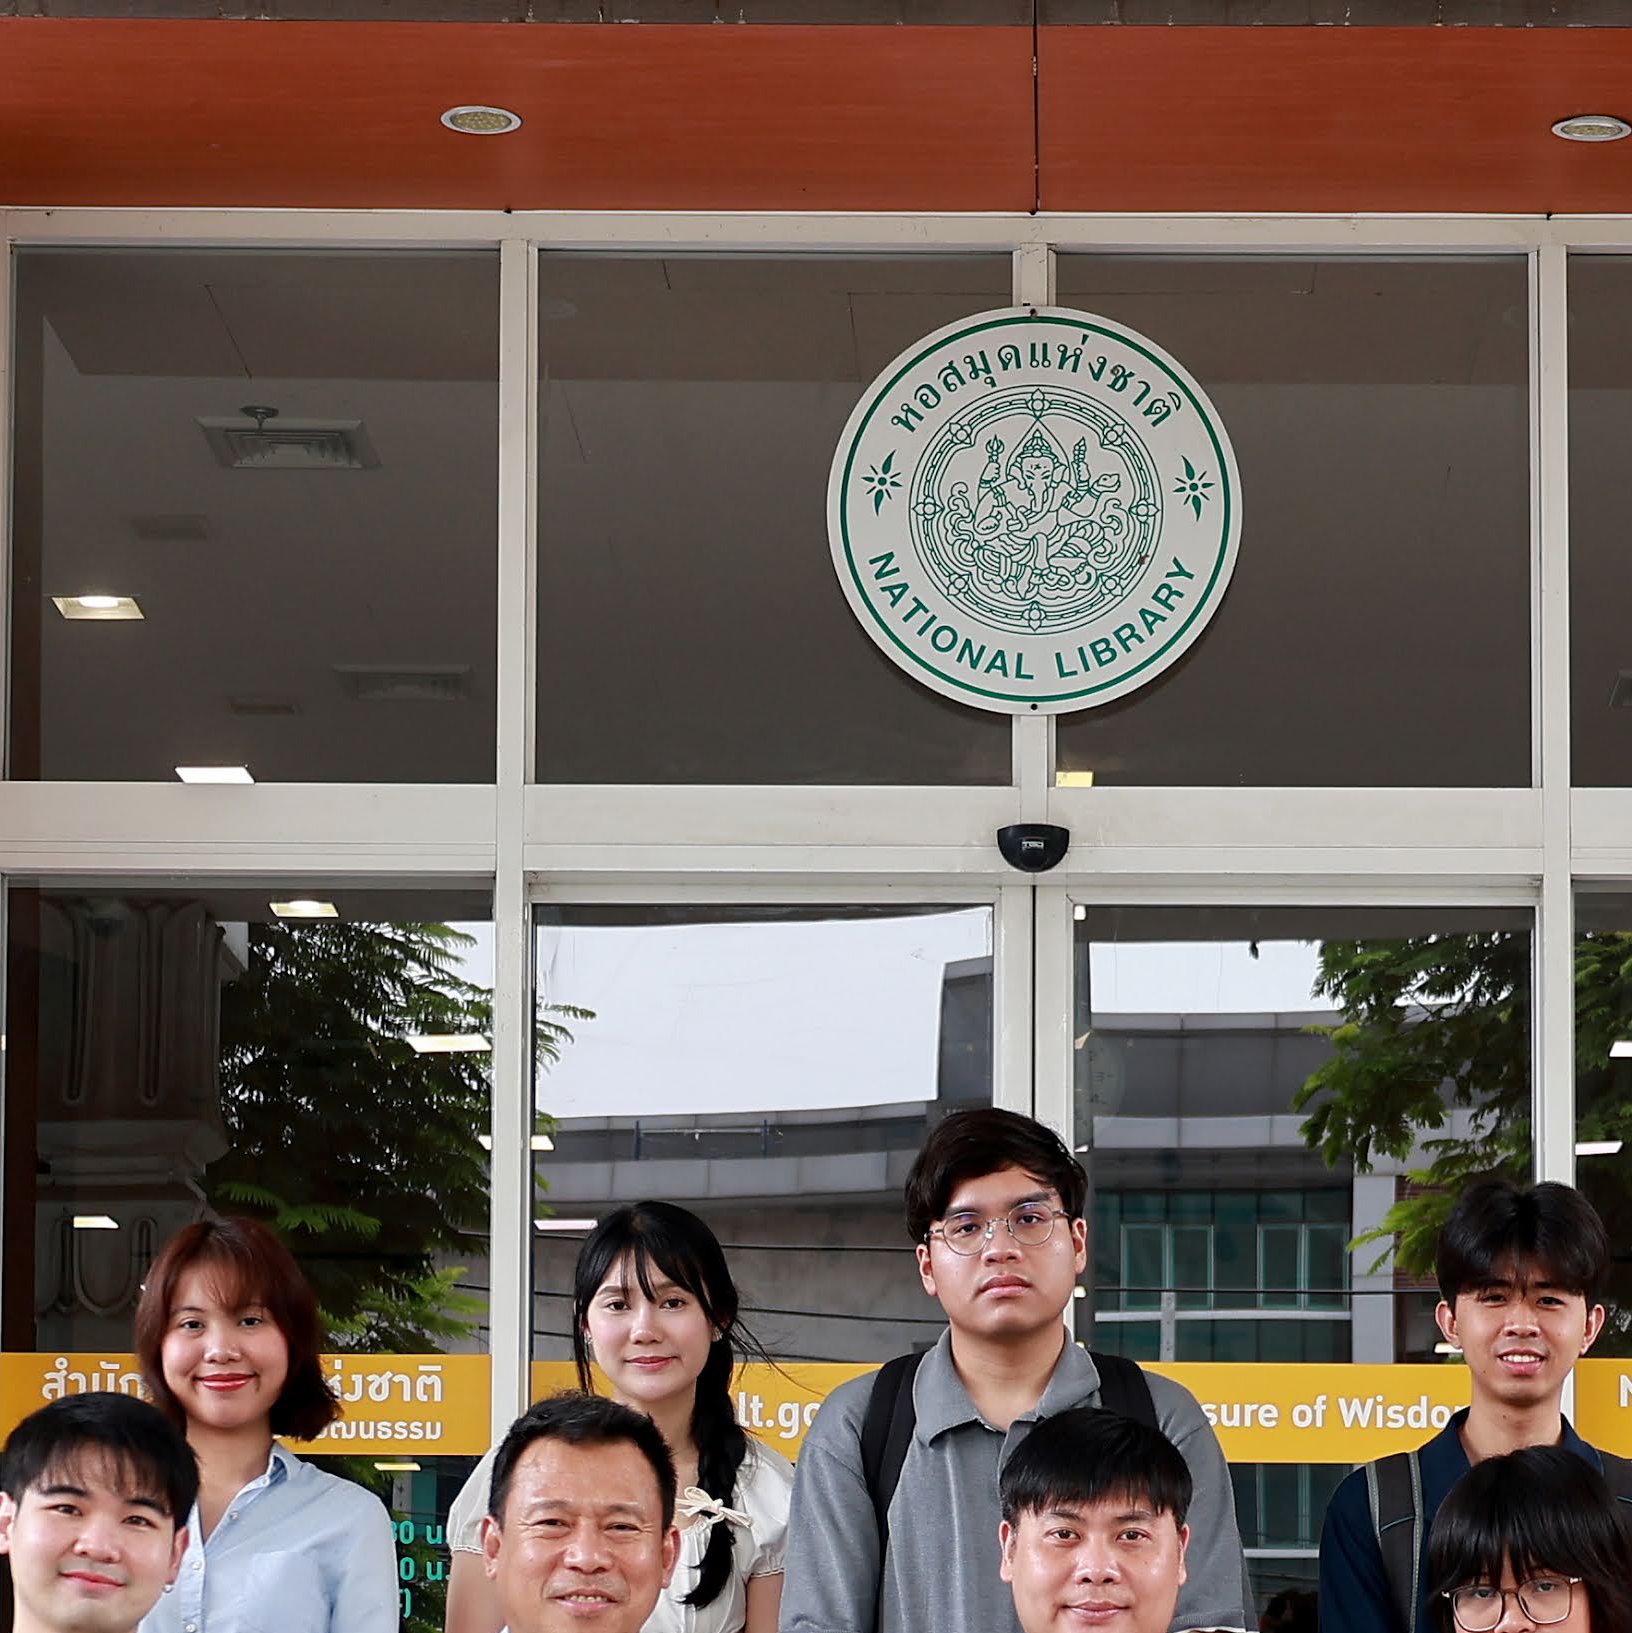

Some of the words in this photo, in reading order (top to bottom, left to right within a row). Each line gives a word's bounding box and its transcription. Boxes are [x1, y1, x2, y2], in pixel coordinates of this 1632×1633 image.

[891, 333, 1182, 433] หอสมุดแห่งชาติ
[868, 550, 1035, 681] NATIONAL
[1054, 556, 1196, 679] LIBRARY
[1292, 1394, 1327, 1428] of
[1338, 1394, 1470, 1429] Wisdo
